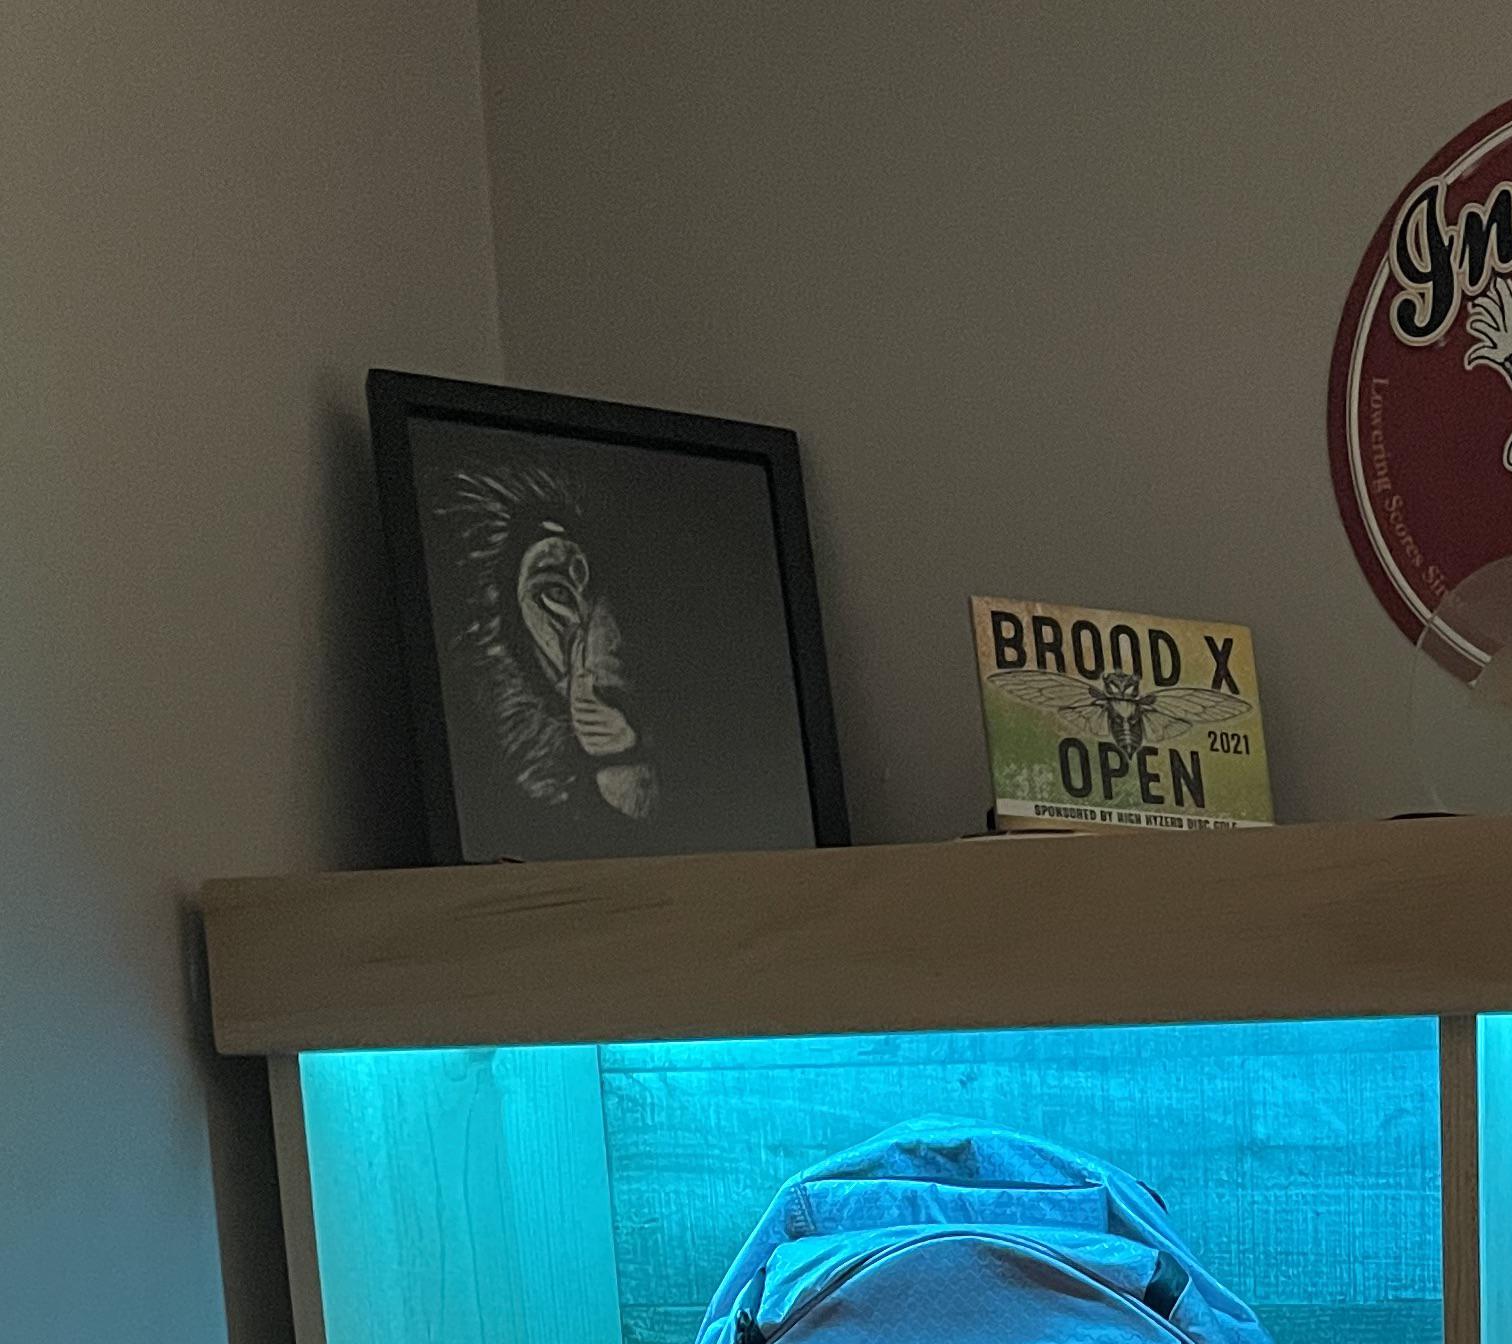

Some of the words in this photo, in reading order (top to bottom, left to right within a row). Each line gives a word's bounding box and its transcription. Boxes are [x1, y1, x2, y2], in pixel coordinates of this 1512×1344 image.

[1370, 377, 1392, 494] Lowering
[1385, 495, 1424, 568] Scores
[990, 610, 1182, 687] BROOD
[1203, 635, 1240, 695] X
[1058, 737, 1206, 809] OPEN
[1207, 730, 1251, 755] 2021
[1034, 804, 1097, 821] SPONSORED
[1100, 809, 1114, 823] BY
